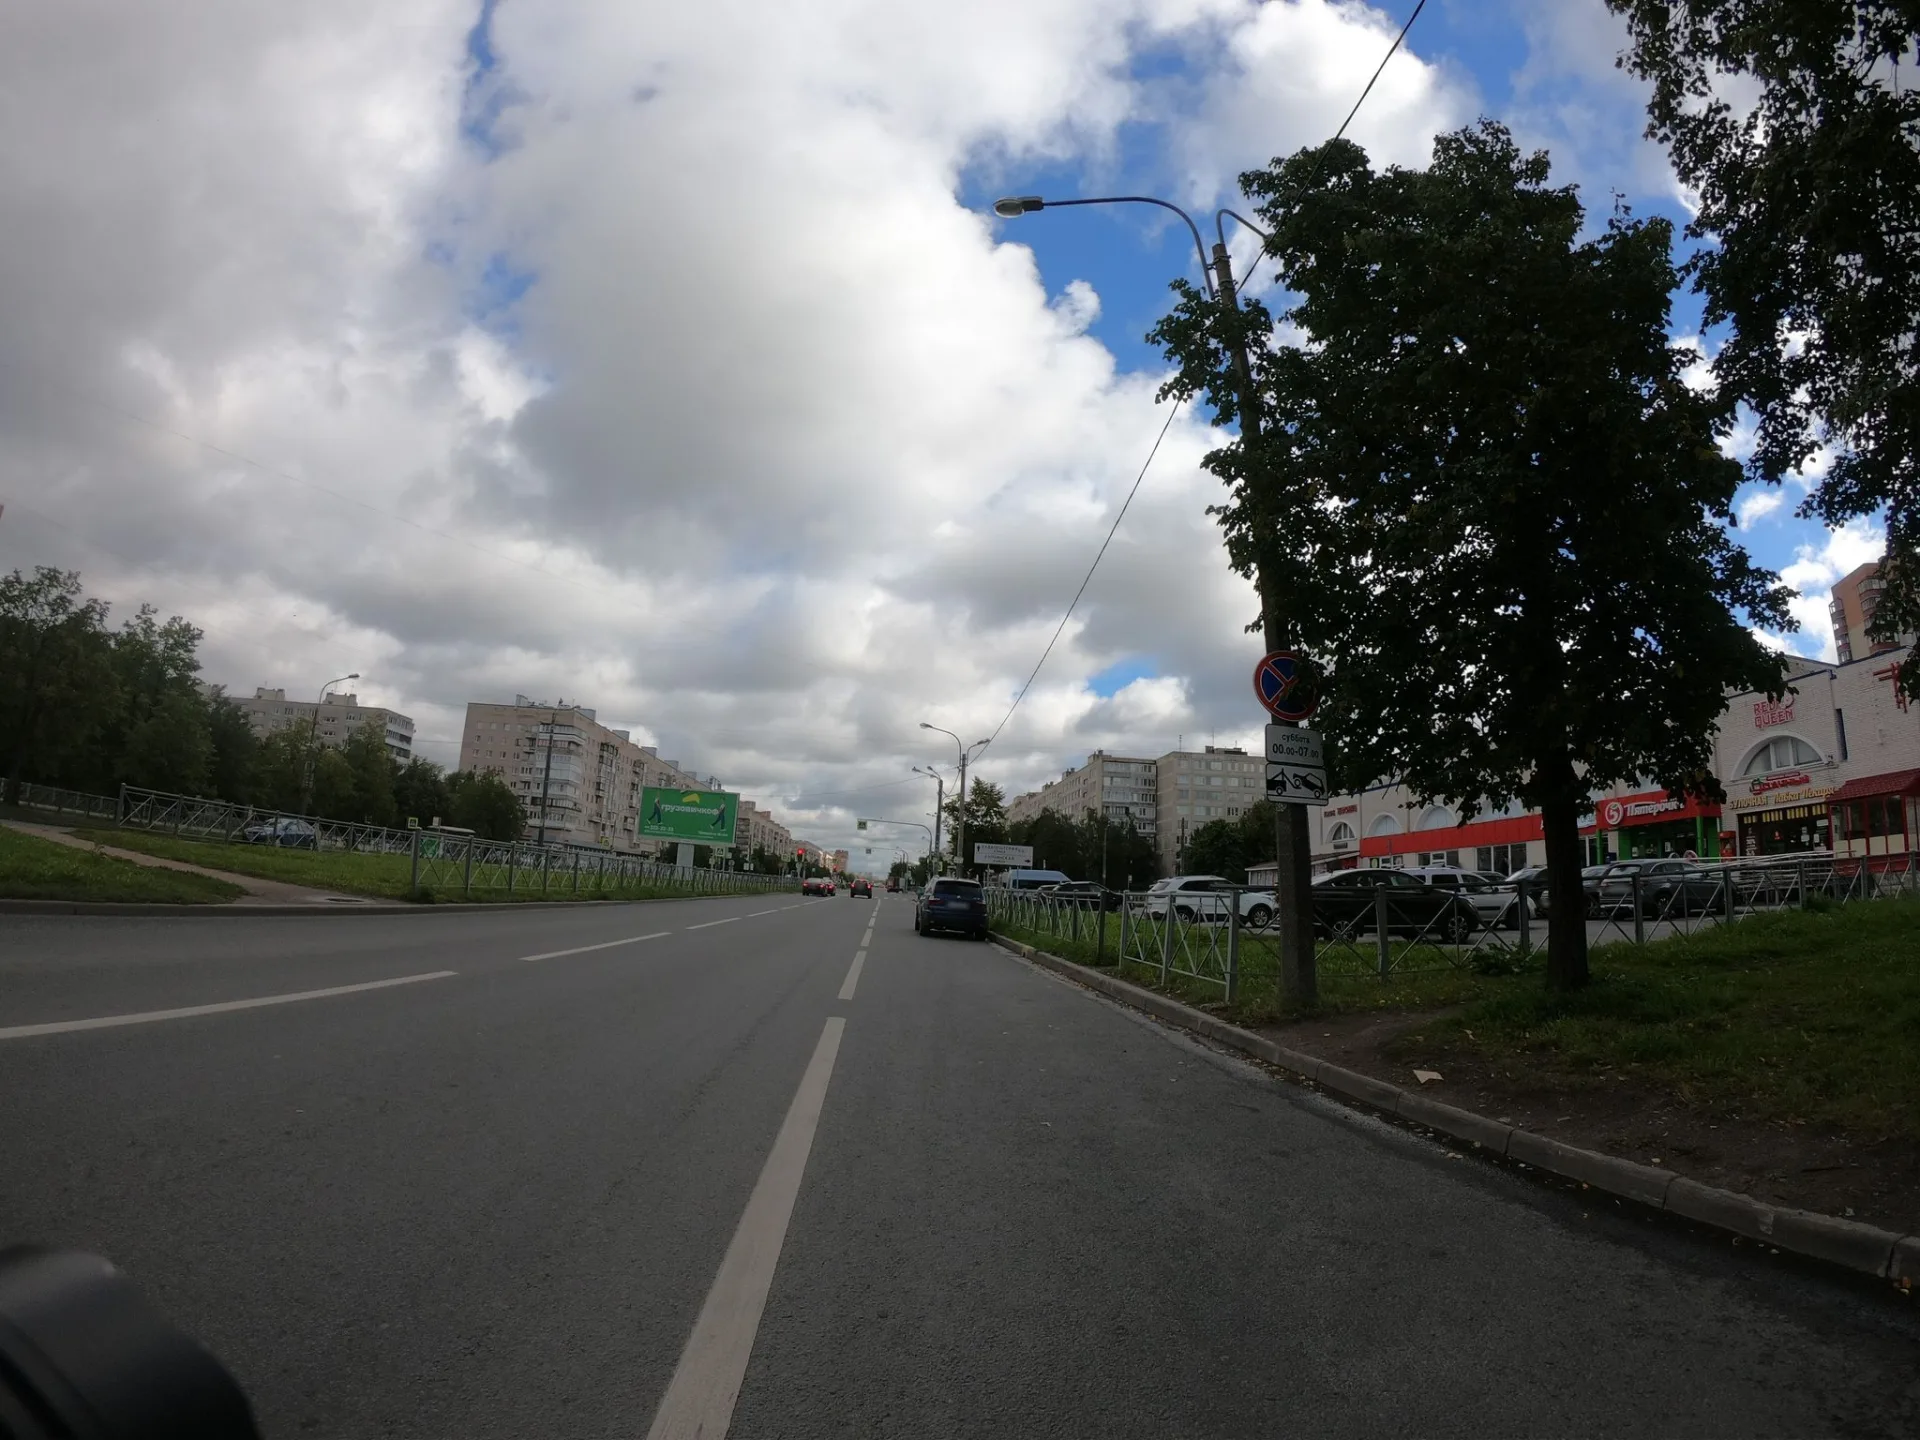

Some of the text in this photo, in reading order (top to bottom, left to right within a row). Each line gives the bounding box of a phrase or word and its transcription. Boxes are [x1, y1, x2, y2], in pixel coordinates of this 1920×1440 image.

[1755, 708, 1794, 728] QUEEN
[1281, 733, 1310, 744] суббота
[661, 804, 719, 815] грузовичкоф
